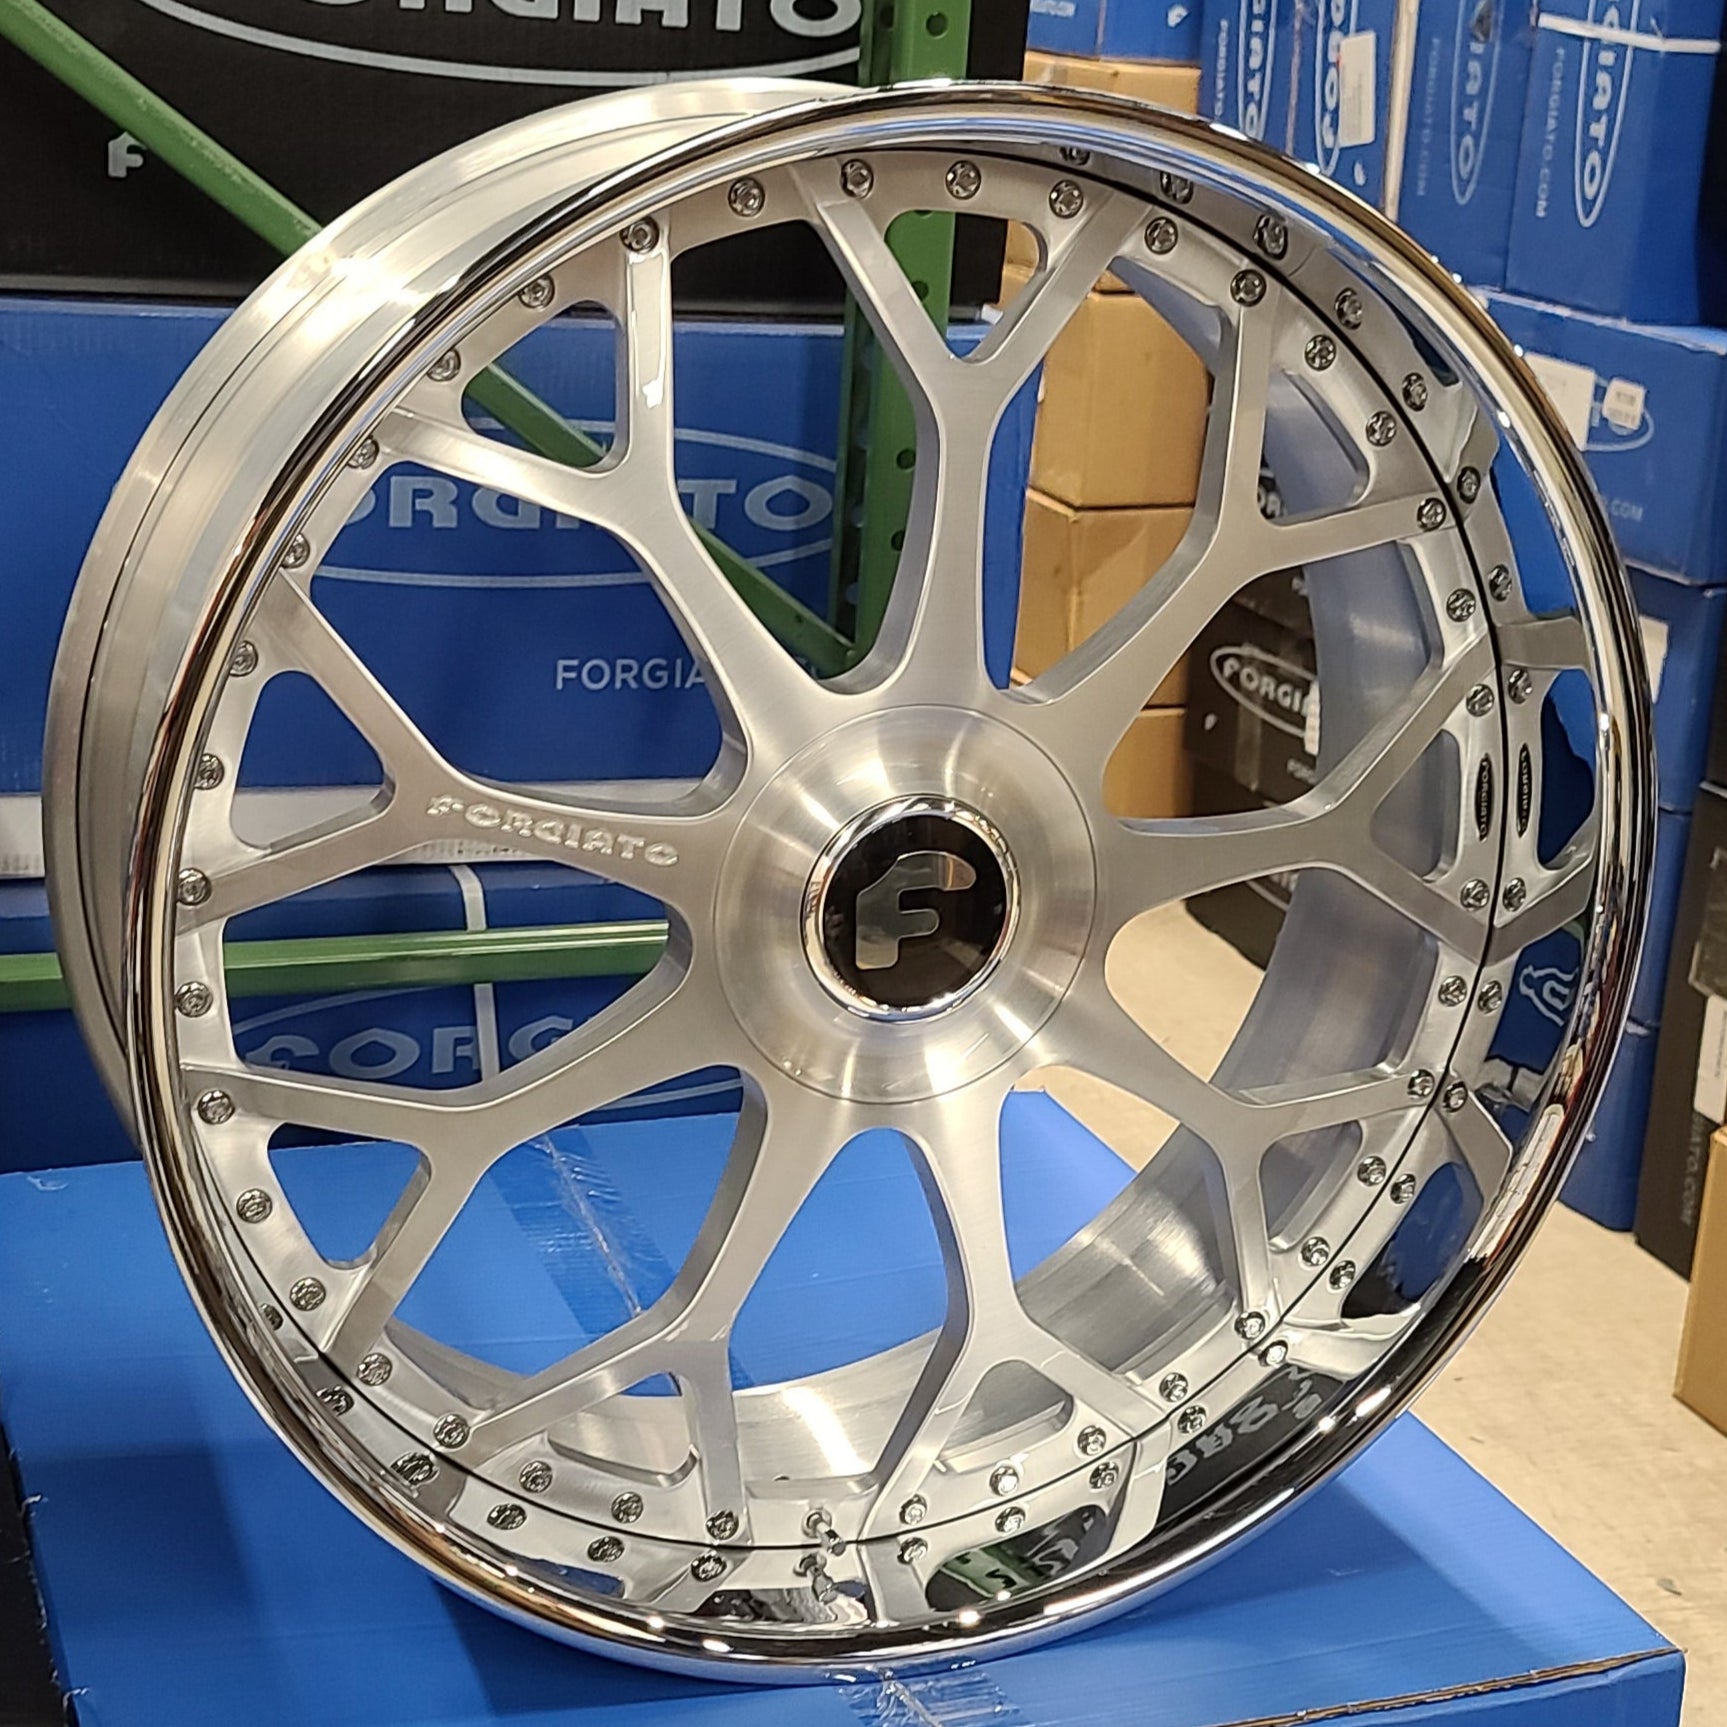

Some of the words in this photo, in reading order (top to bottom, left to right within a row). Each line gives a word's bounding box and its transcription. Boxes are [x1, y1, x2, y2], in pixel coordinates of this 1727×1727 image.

[1535, 47, 1565, 219] FORGIATO.COM
[426, 794, 680, 867] FORGIATO
[1480, 760, 1490, 836] FORGIATO
